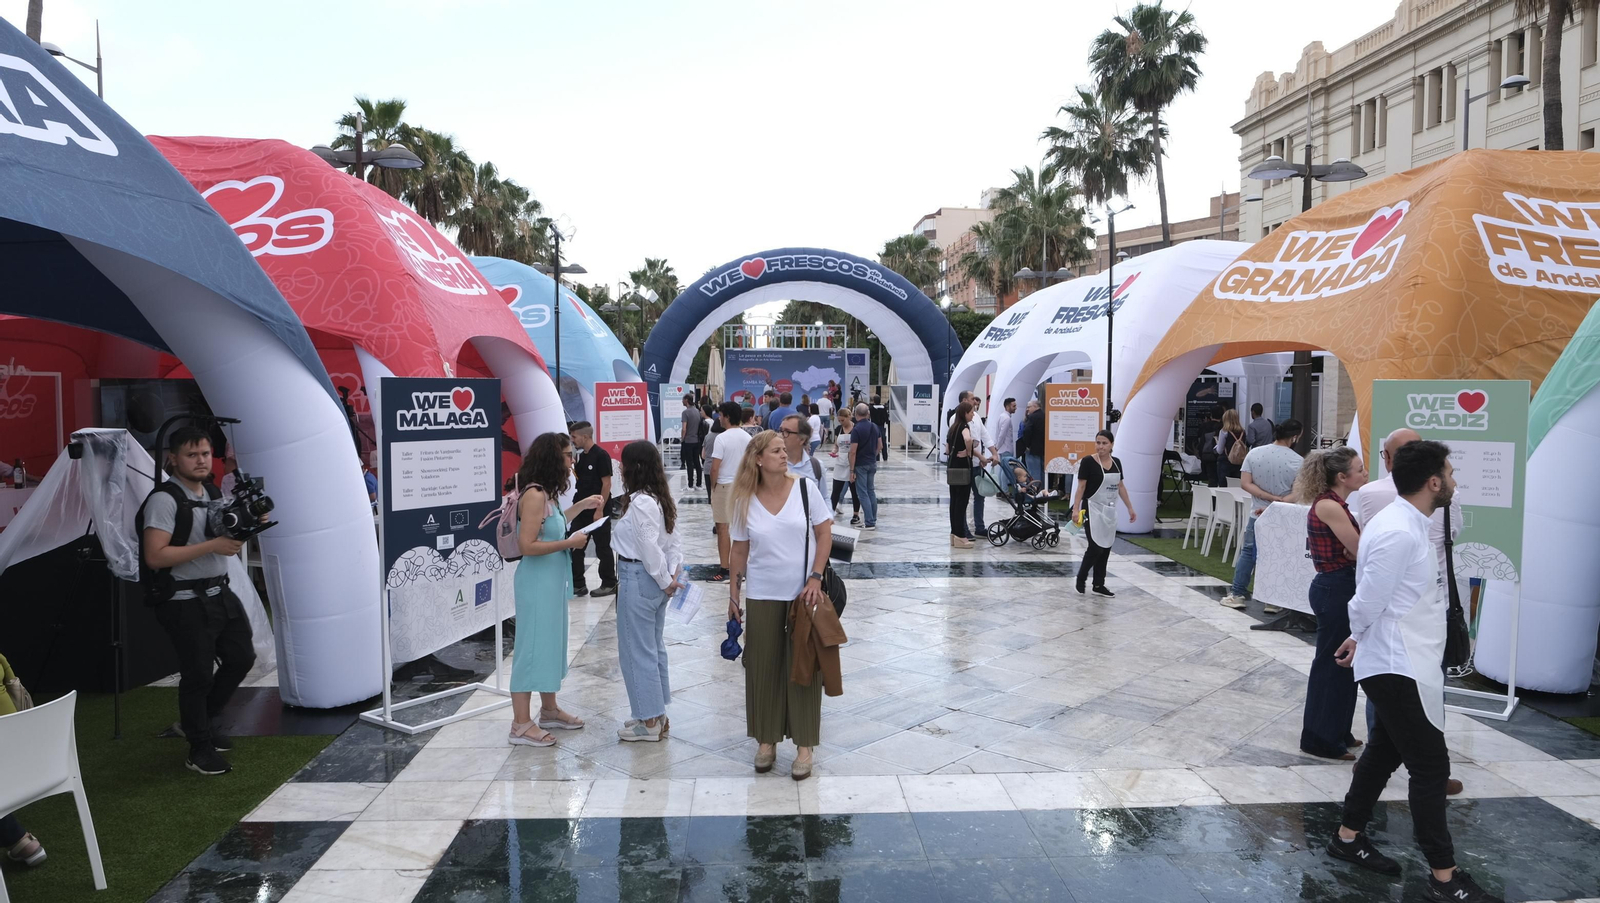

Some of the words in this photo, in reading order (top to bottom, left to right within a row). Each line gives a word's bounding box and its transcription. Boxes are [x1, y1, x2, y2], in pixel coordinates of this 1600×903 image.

[1279, 232, 1360, 263] WE
[701, 268, 742, 295] WE
[767, 256, 869, 278] FRESCOS
[1218, 241, 1400, 297] GRANADA
[1497, 262, 1528, 279] de
[1083, 284, 1120, 302] WE
[776, 329, 800, 337] DEL
[805, 329, 836, 337] MAR
[415, 395, 450, 409] WE
[602, 397, 641, 405] ALMERÍA
[1410, 396, 1455, 410] WE
[1357, 850, 1369, 859] N
[1454, 889, 1468, 899] N
